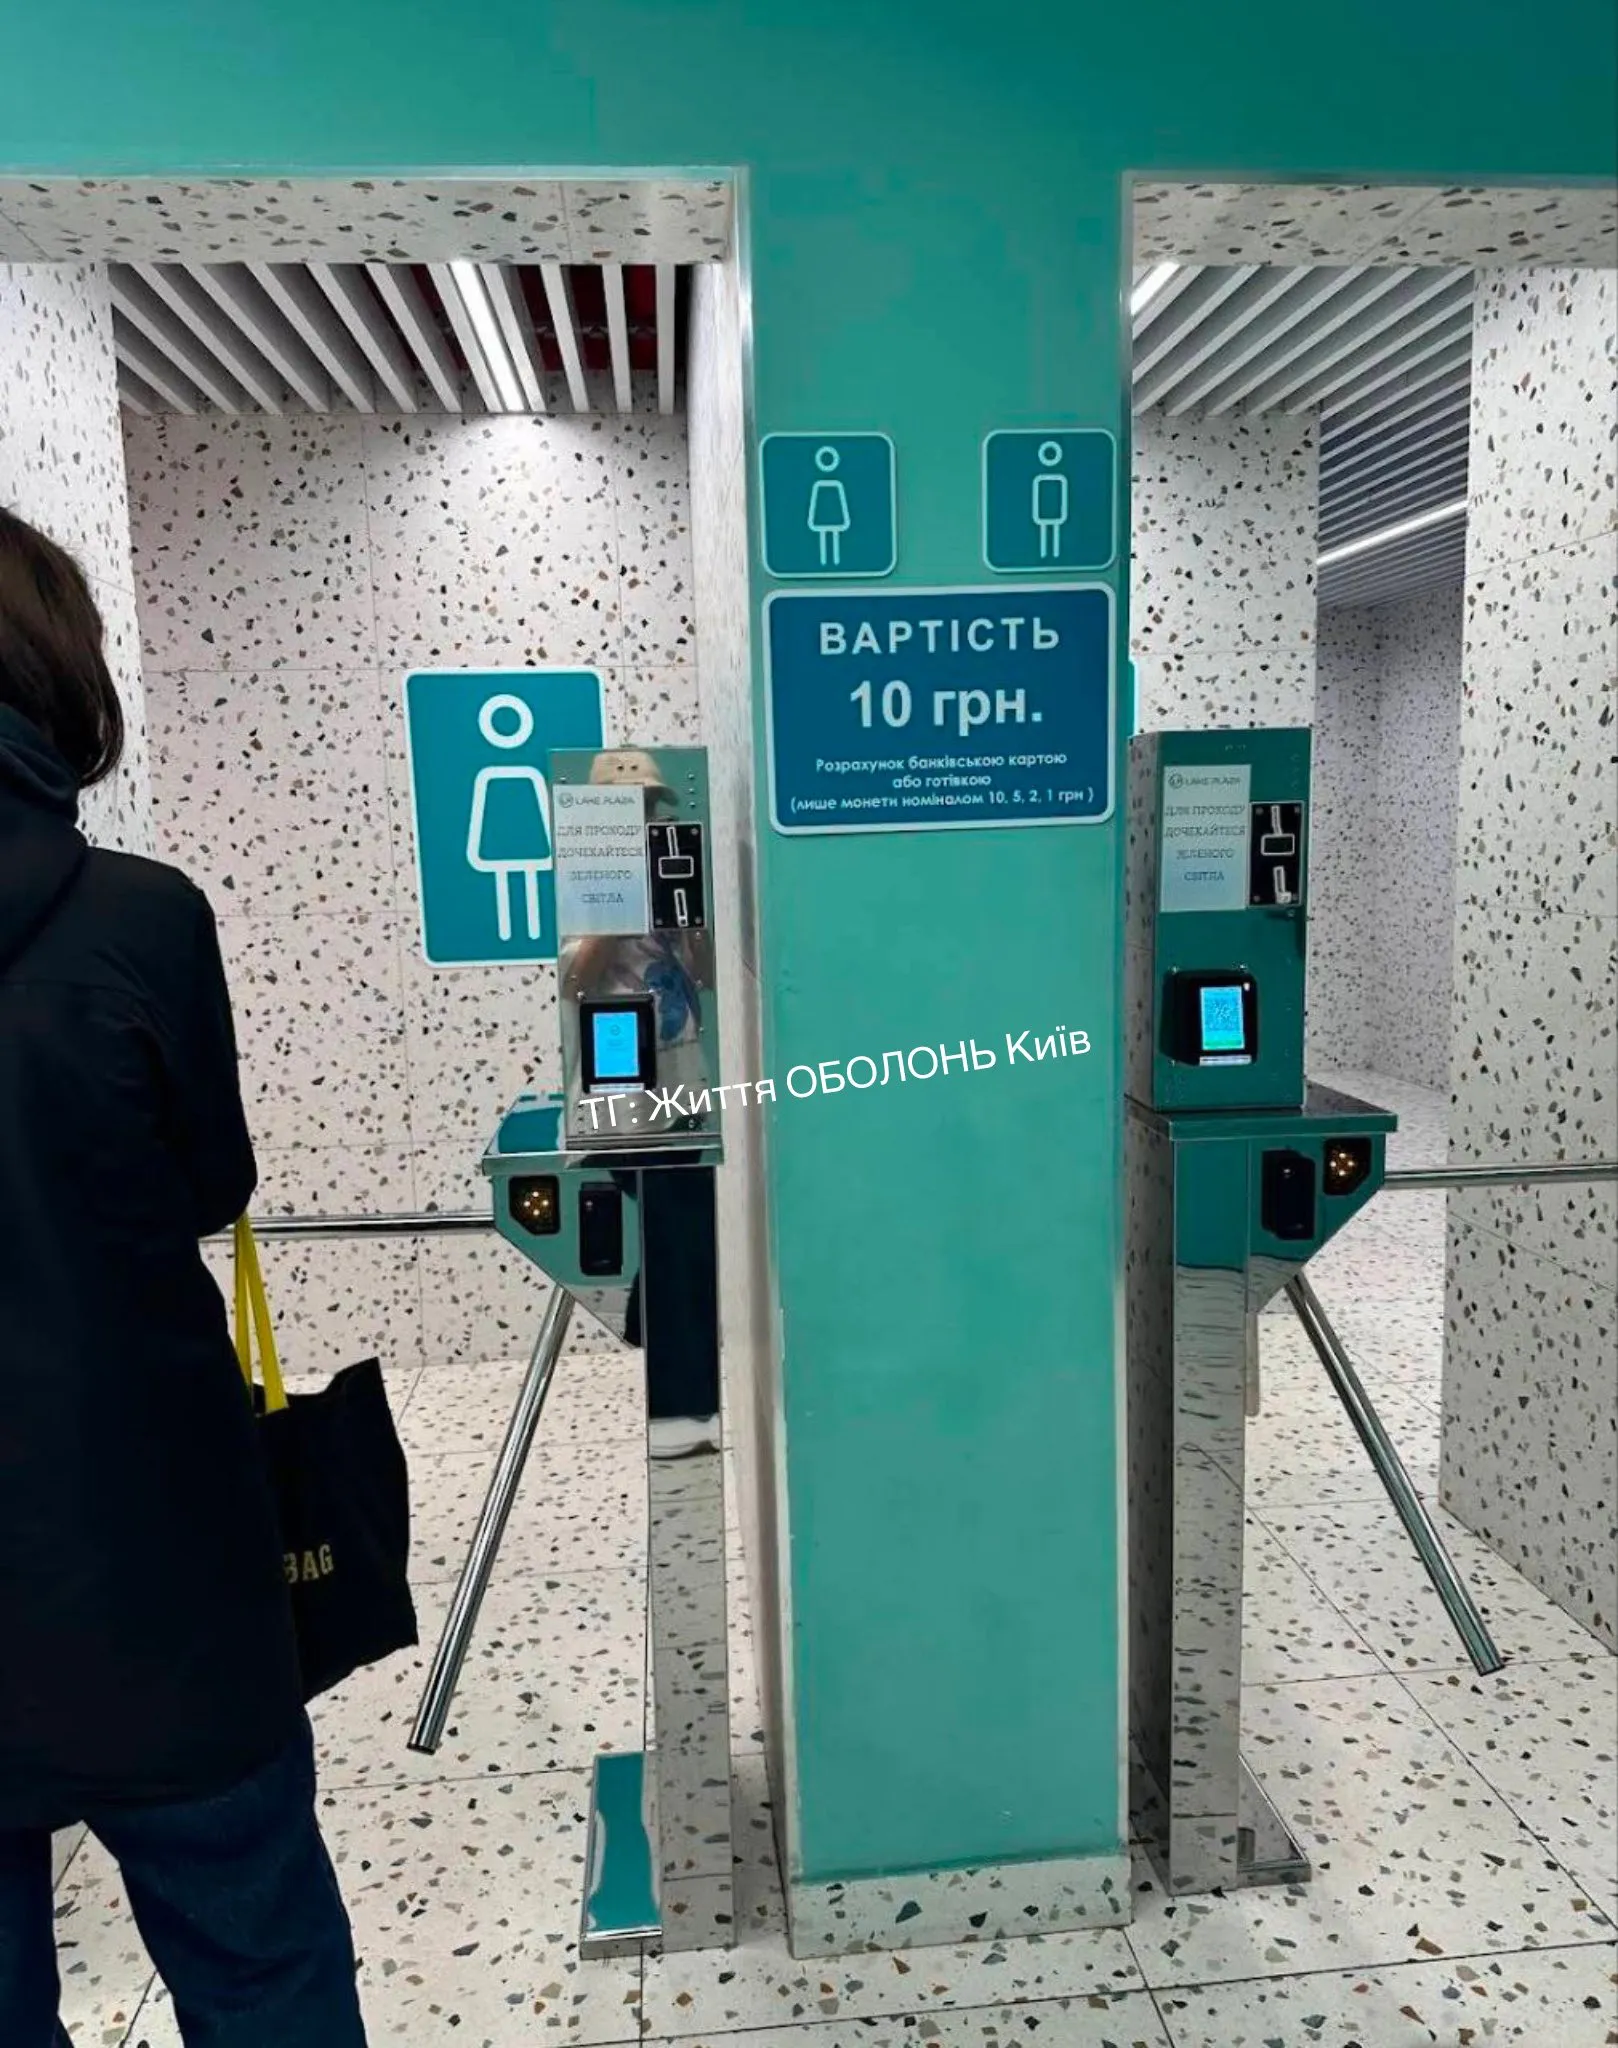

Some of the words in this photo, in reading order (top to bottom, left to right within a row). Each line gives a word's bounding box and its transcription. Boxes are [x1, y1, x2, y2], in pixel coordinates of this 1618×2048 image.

[819, 617, 1060, 655] ВАРТІСТЬ
[850, 680, 912, 728] 10
[933, 688, 1043, 736] грн.
[816, 758, 904, 774] Розрахунок
[908, 754, 1005, 770] банківською
[1008, 753, 1067, 768] картою
[892, 775, 922, 789] або
[925, 773, 992, 788] готівкою
[791, 796, 837, 814] (лише
[840, 797, 898, 809] монети
[901, 793, 984, 808] номіналом
[1058, 790, 1084, 804] грн
[283, 1544, 334, 1584] BAG
